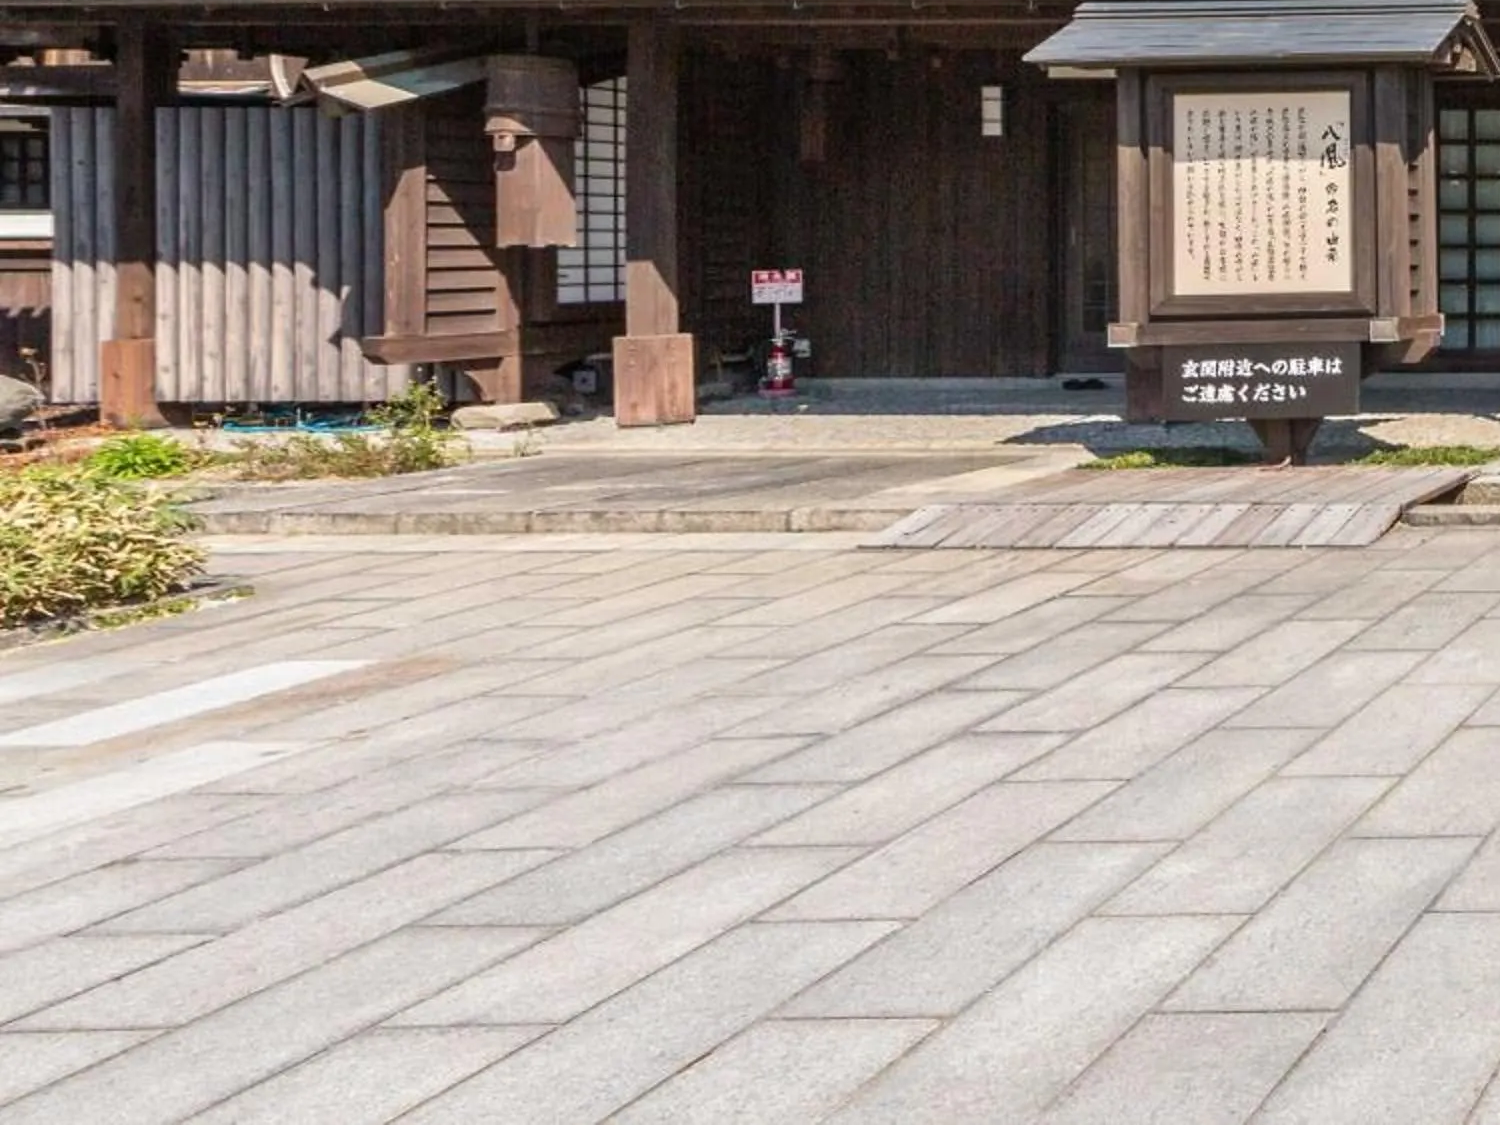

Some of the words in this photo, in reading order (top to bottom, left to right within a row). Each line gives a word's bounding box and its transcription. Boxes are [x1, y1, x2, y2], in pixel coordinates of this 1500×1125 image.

[1182, 383, 1307, 403] ご遠慮ください
